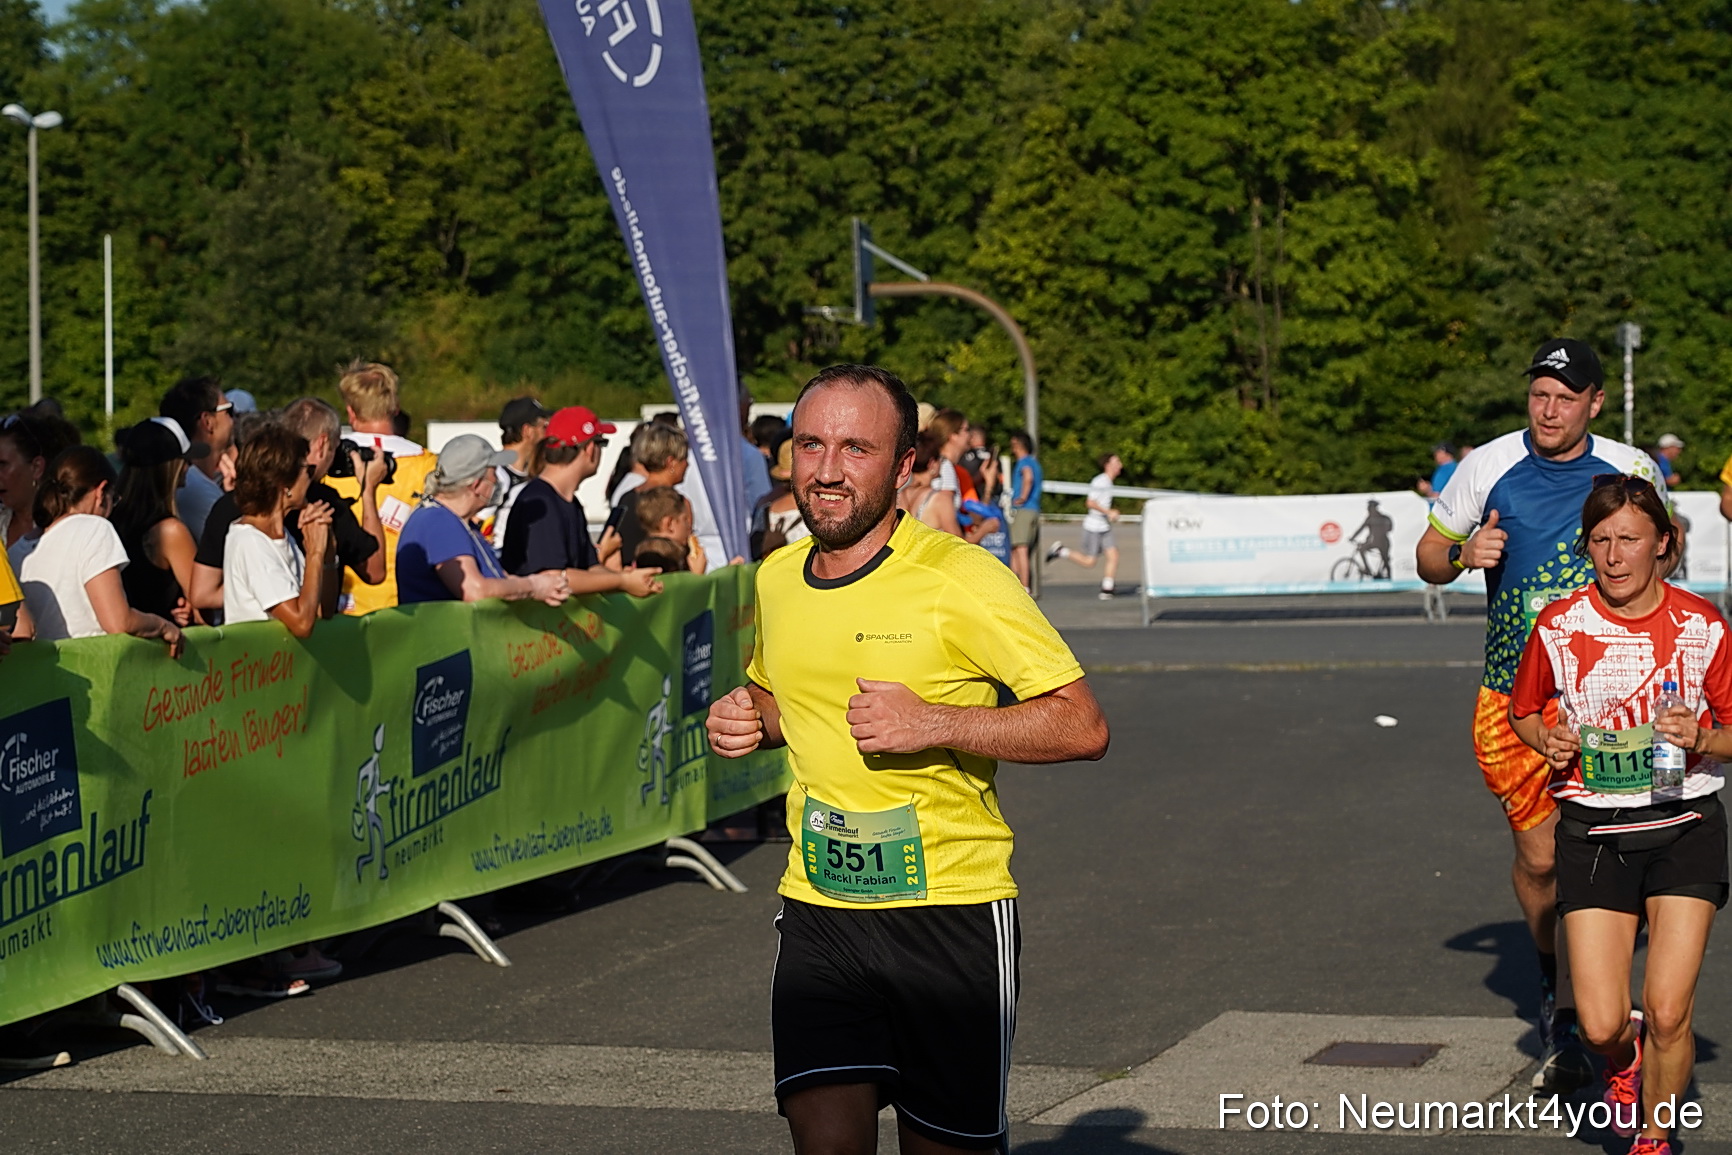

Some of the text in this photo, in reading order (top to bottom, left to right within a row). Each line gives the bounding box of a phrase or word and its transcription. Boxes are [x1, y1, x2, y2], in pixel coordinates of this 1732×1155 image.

[865, 633, 912, 641] SPANGLER
[143, 651, 294, 732] Gesunde Firmen
[422, 689, 465, 718] Fischer
[183, 684, 308, 779] laufen länger!
[9, 748, 59, 783] Fischer
[1585, 755, 1595, 779] RUN
[1595, 747, 1653, 774] 1118
[15, 770, 56, 796] AUTOMOBILE
[388, 725, 513, 841] firmenlauf
[1595, 773, 1637, 785] Gerngroß
[825, 823, 859, 835] Firmenlauf
[394, 824, 444, 868] neumarkt
[807, 841, 818, 874] RUN
[826, 838, 884, 872] 551
[824, 868, 897, 886] Rackl Fabian
[902, 843, 919, 885] 2022
[95, 882, 313, 970] www.firmenlauf-oberpfalz.de
